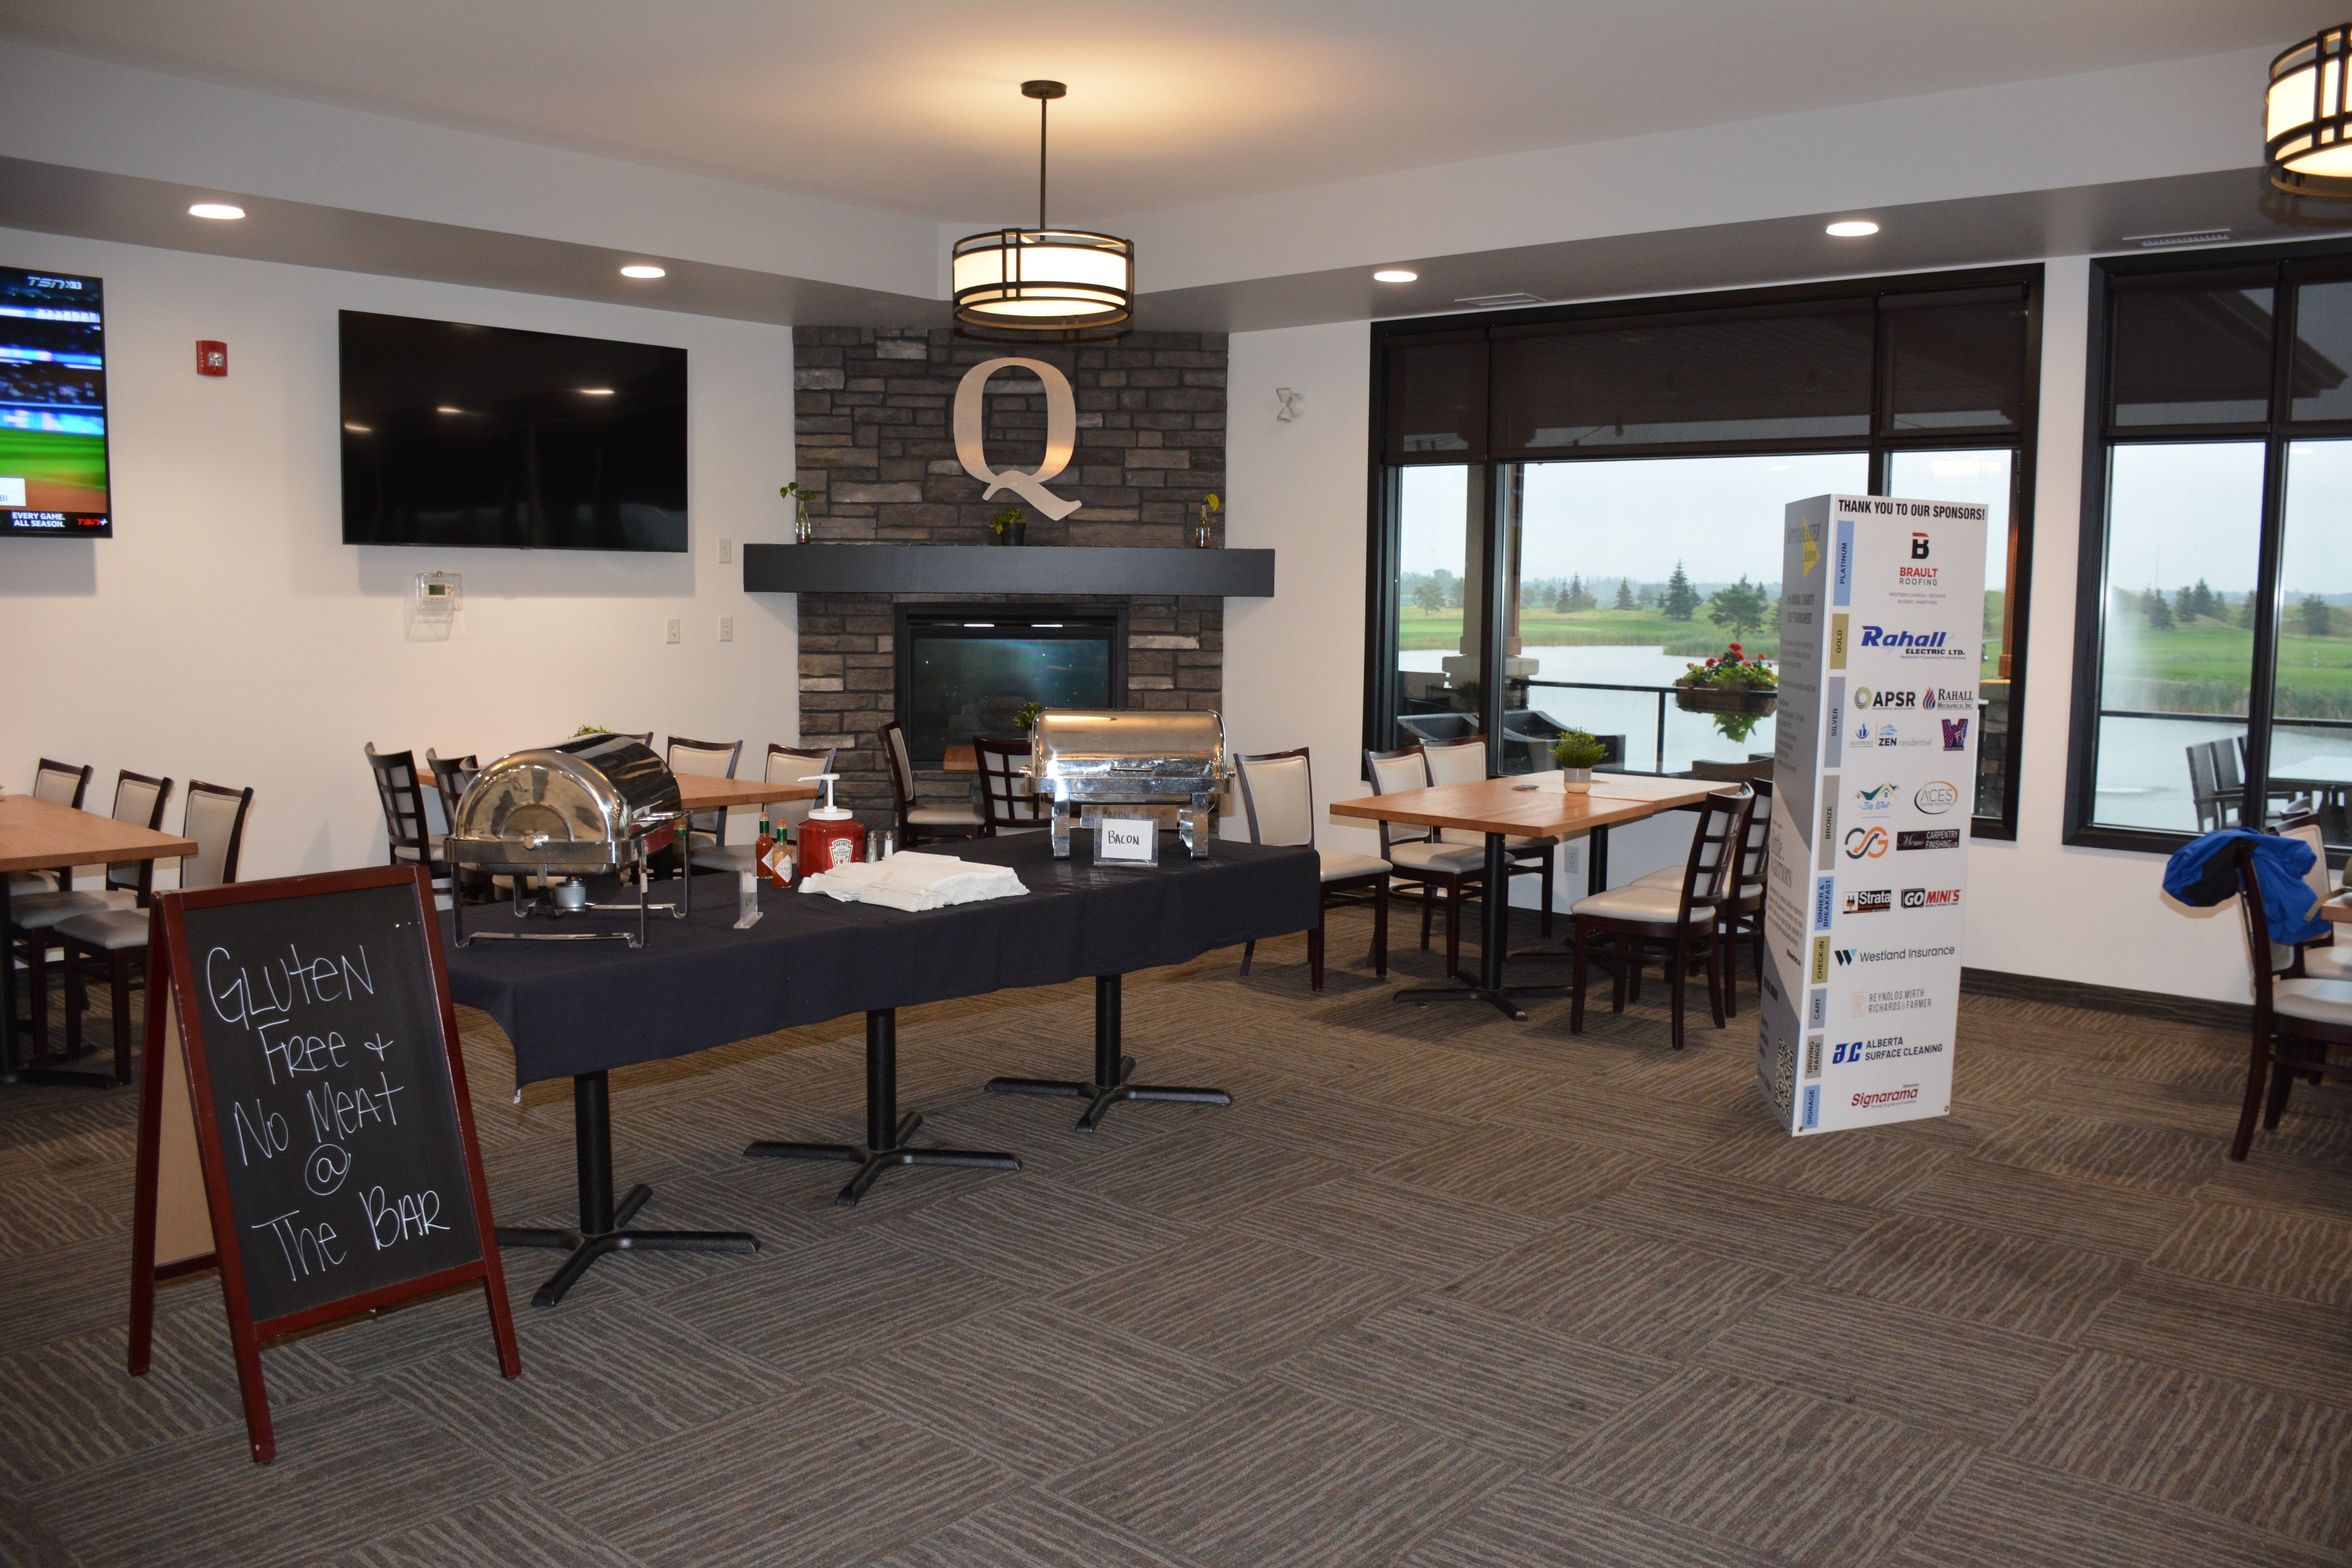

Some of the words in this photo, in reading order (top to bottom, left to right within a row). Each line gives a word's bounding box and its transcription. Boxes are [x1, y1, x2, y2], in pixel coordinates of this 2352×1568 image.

[953, 357, 1081, 521] Q
[1838, 499, 1871, 513] THANK
[1875, 502, 1893, 514] YOU
[1896, 503, 1907, 515] TO
[1911, 505, 1929, 517] OUR
[1933, 506, 1985, 520] SPONSORS!
[1900, 567, 1938, 577] BRAULT
[1861, 626, 1947, 647] Rahall
[1873, 691, 1915, 707] APSR
[1938, 689, 1973, 701] RAHALL
[1899, 738, 1932, 746] residential
[1921, 789, 1953, 802] ACES
[1108, 830, 1139, 846] BACON
[1927, 831, 1958, 839] CARPENTRY
[1926, 840, 1951, 849] FINISHING
[1859, 892, 1891, 904] Strata
[1905, 892, 1924, 906] GO
[1926, 889, 1960, 904] MINI'S
[1860, 949, 1906, 962] Westland
[1909, 947, 1955, 958] Insurance
[1869, 991, 1902, 1002] REYNOLDS
[1905, 989, 1924, 999] MIRTH
[1868, 1002, 1900, 1013] RICHARDS
[1906, 999, 1931, 1009] FARMER
[1866, 1037, 1903, 1049] ALBERTA
[1865, 1049, 1901, 1061] SURFACE
[1904, 1044, 1942, 1056] CLEANING
[1851, 1088, 1918, 1108] Signarama
[305, 1143, 351, 1195] @
